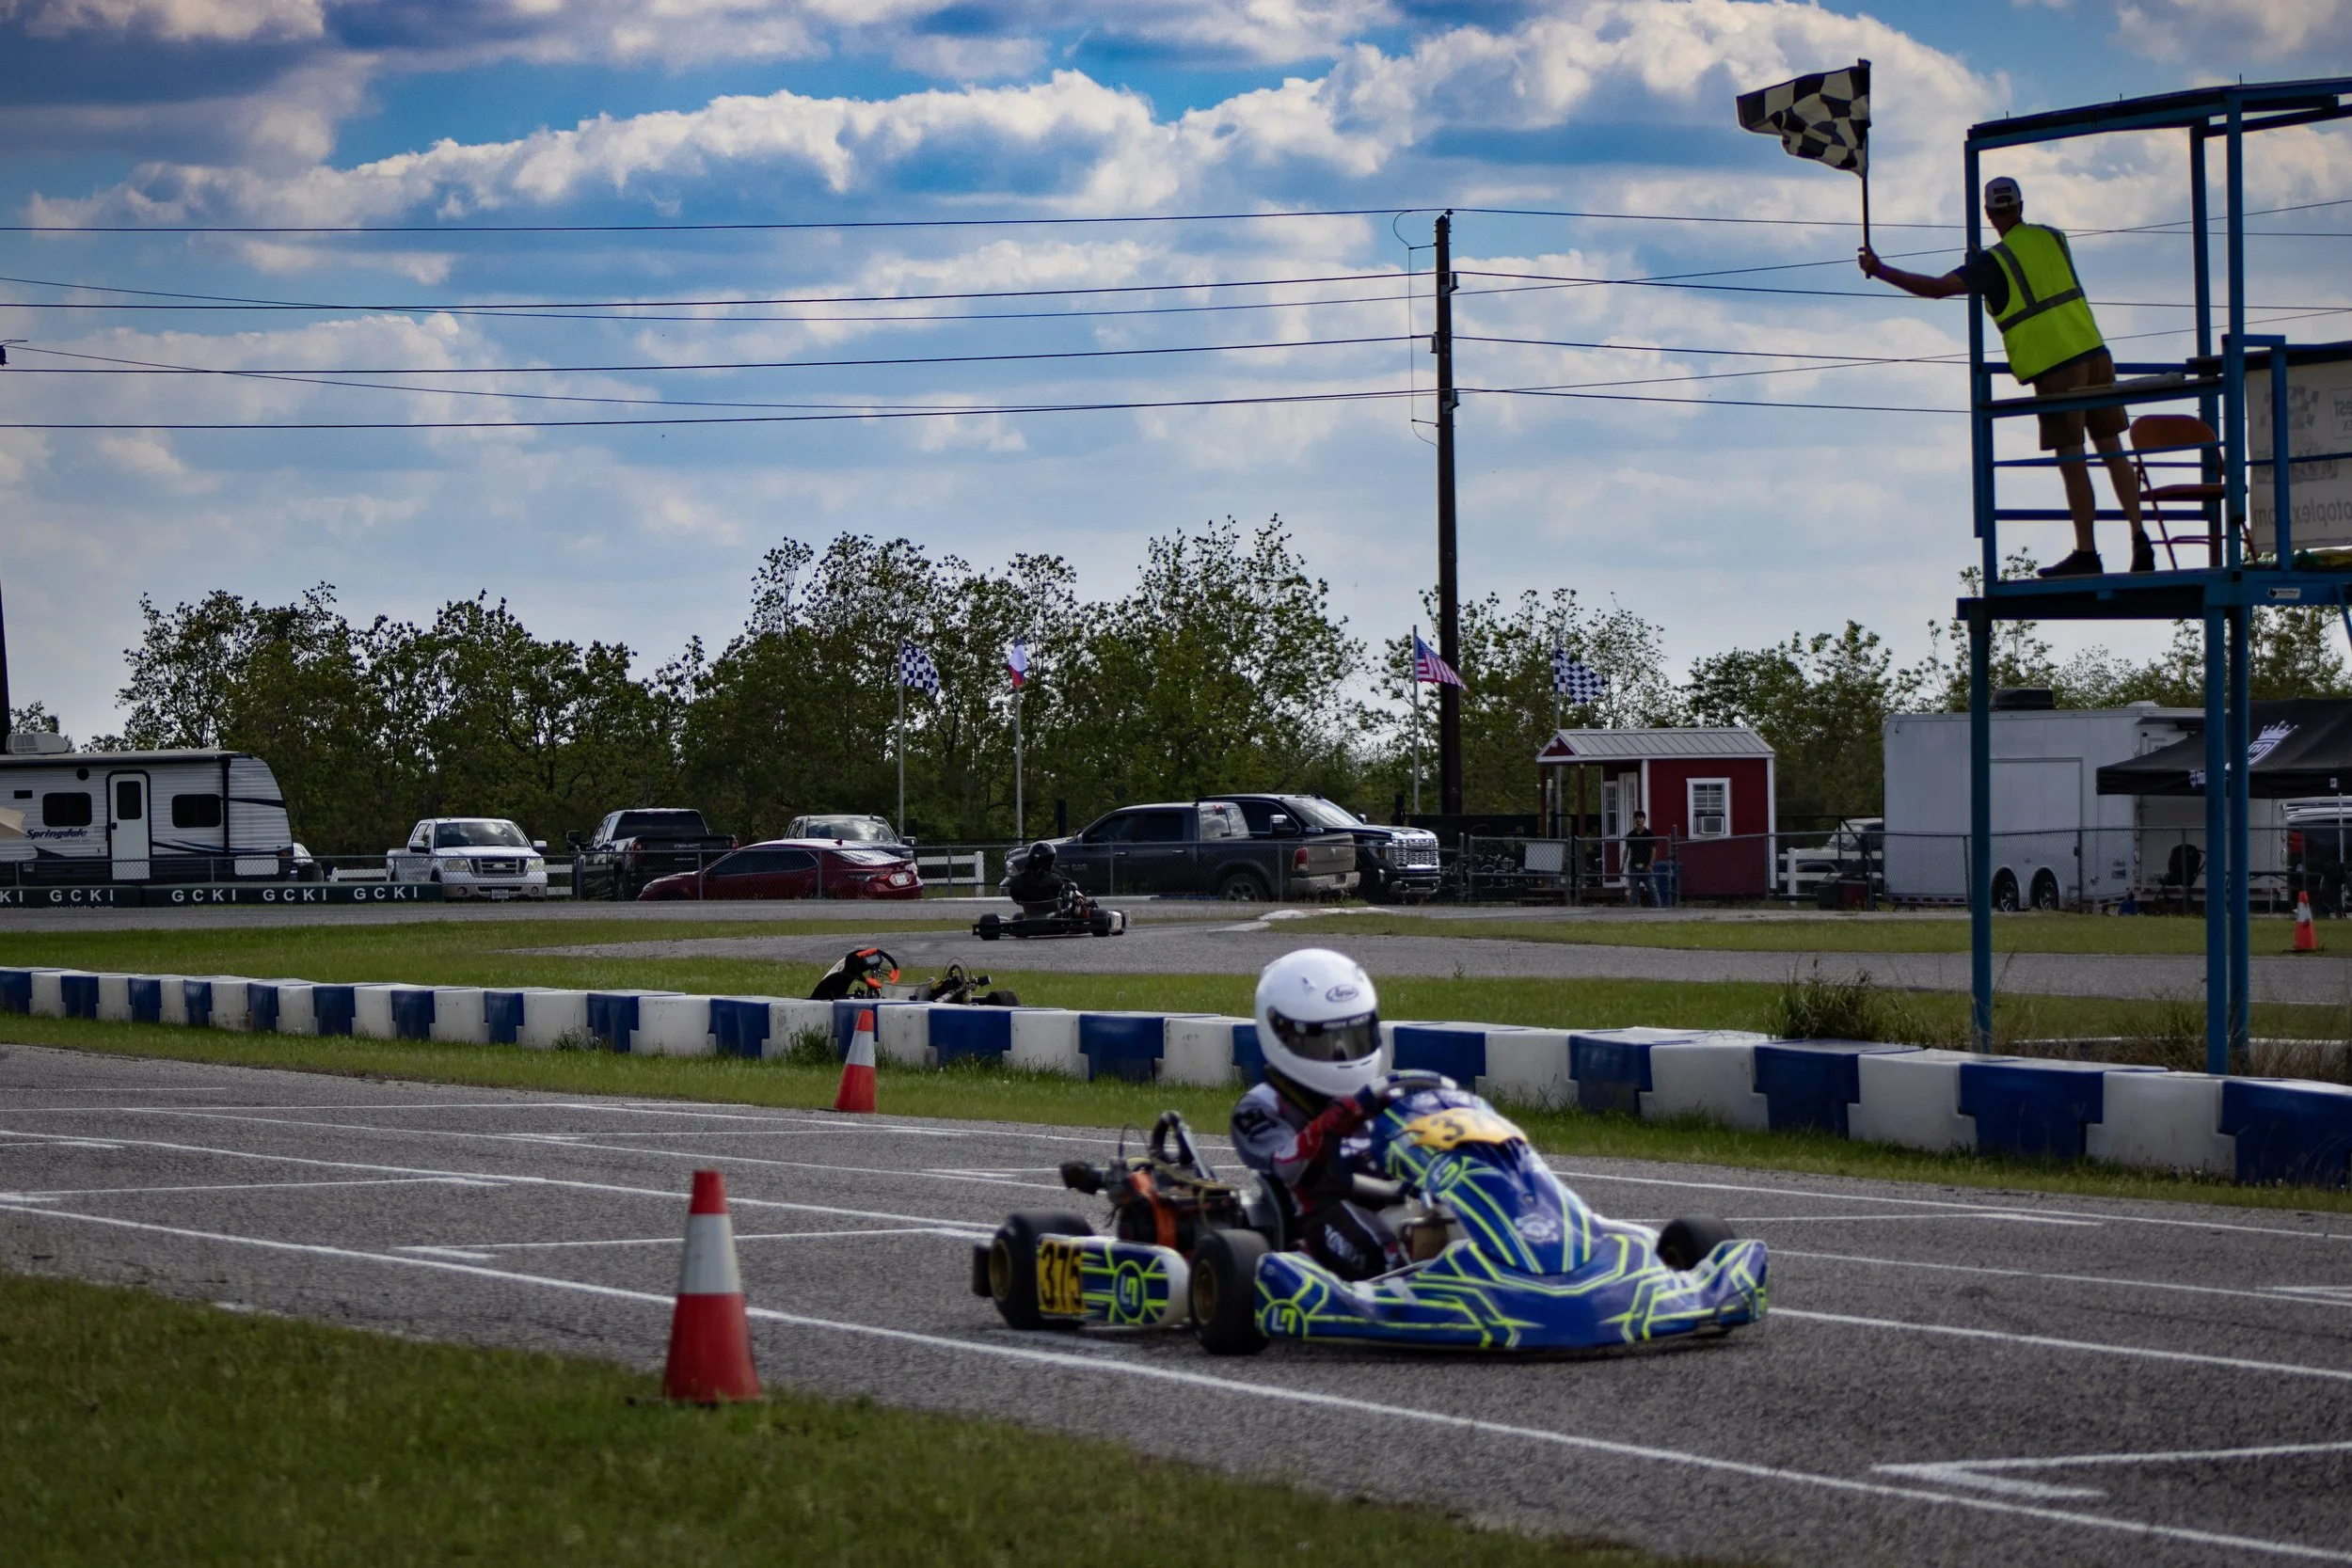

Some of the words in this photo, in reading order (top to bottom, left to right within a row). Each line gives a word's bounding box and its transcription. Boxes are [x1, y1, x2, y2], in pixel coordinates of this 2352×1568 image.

[24, 828, 88, 840] Springdale
[49, 889, 114, 903] GCKI
[171, 889, 236, 903] GCKI
[262, 888, 327, 902] GCKI
[353, 886, 419, 901] GCKI
